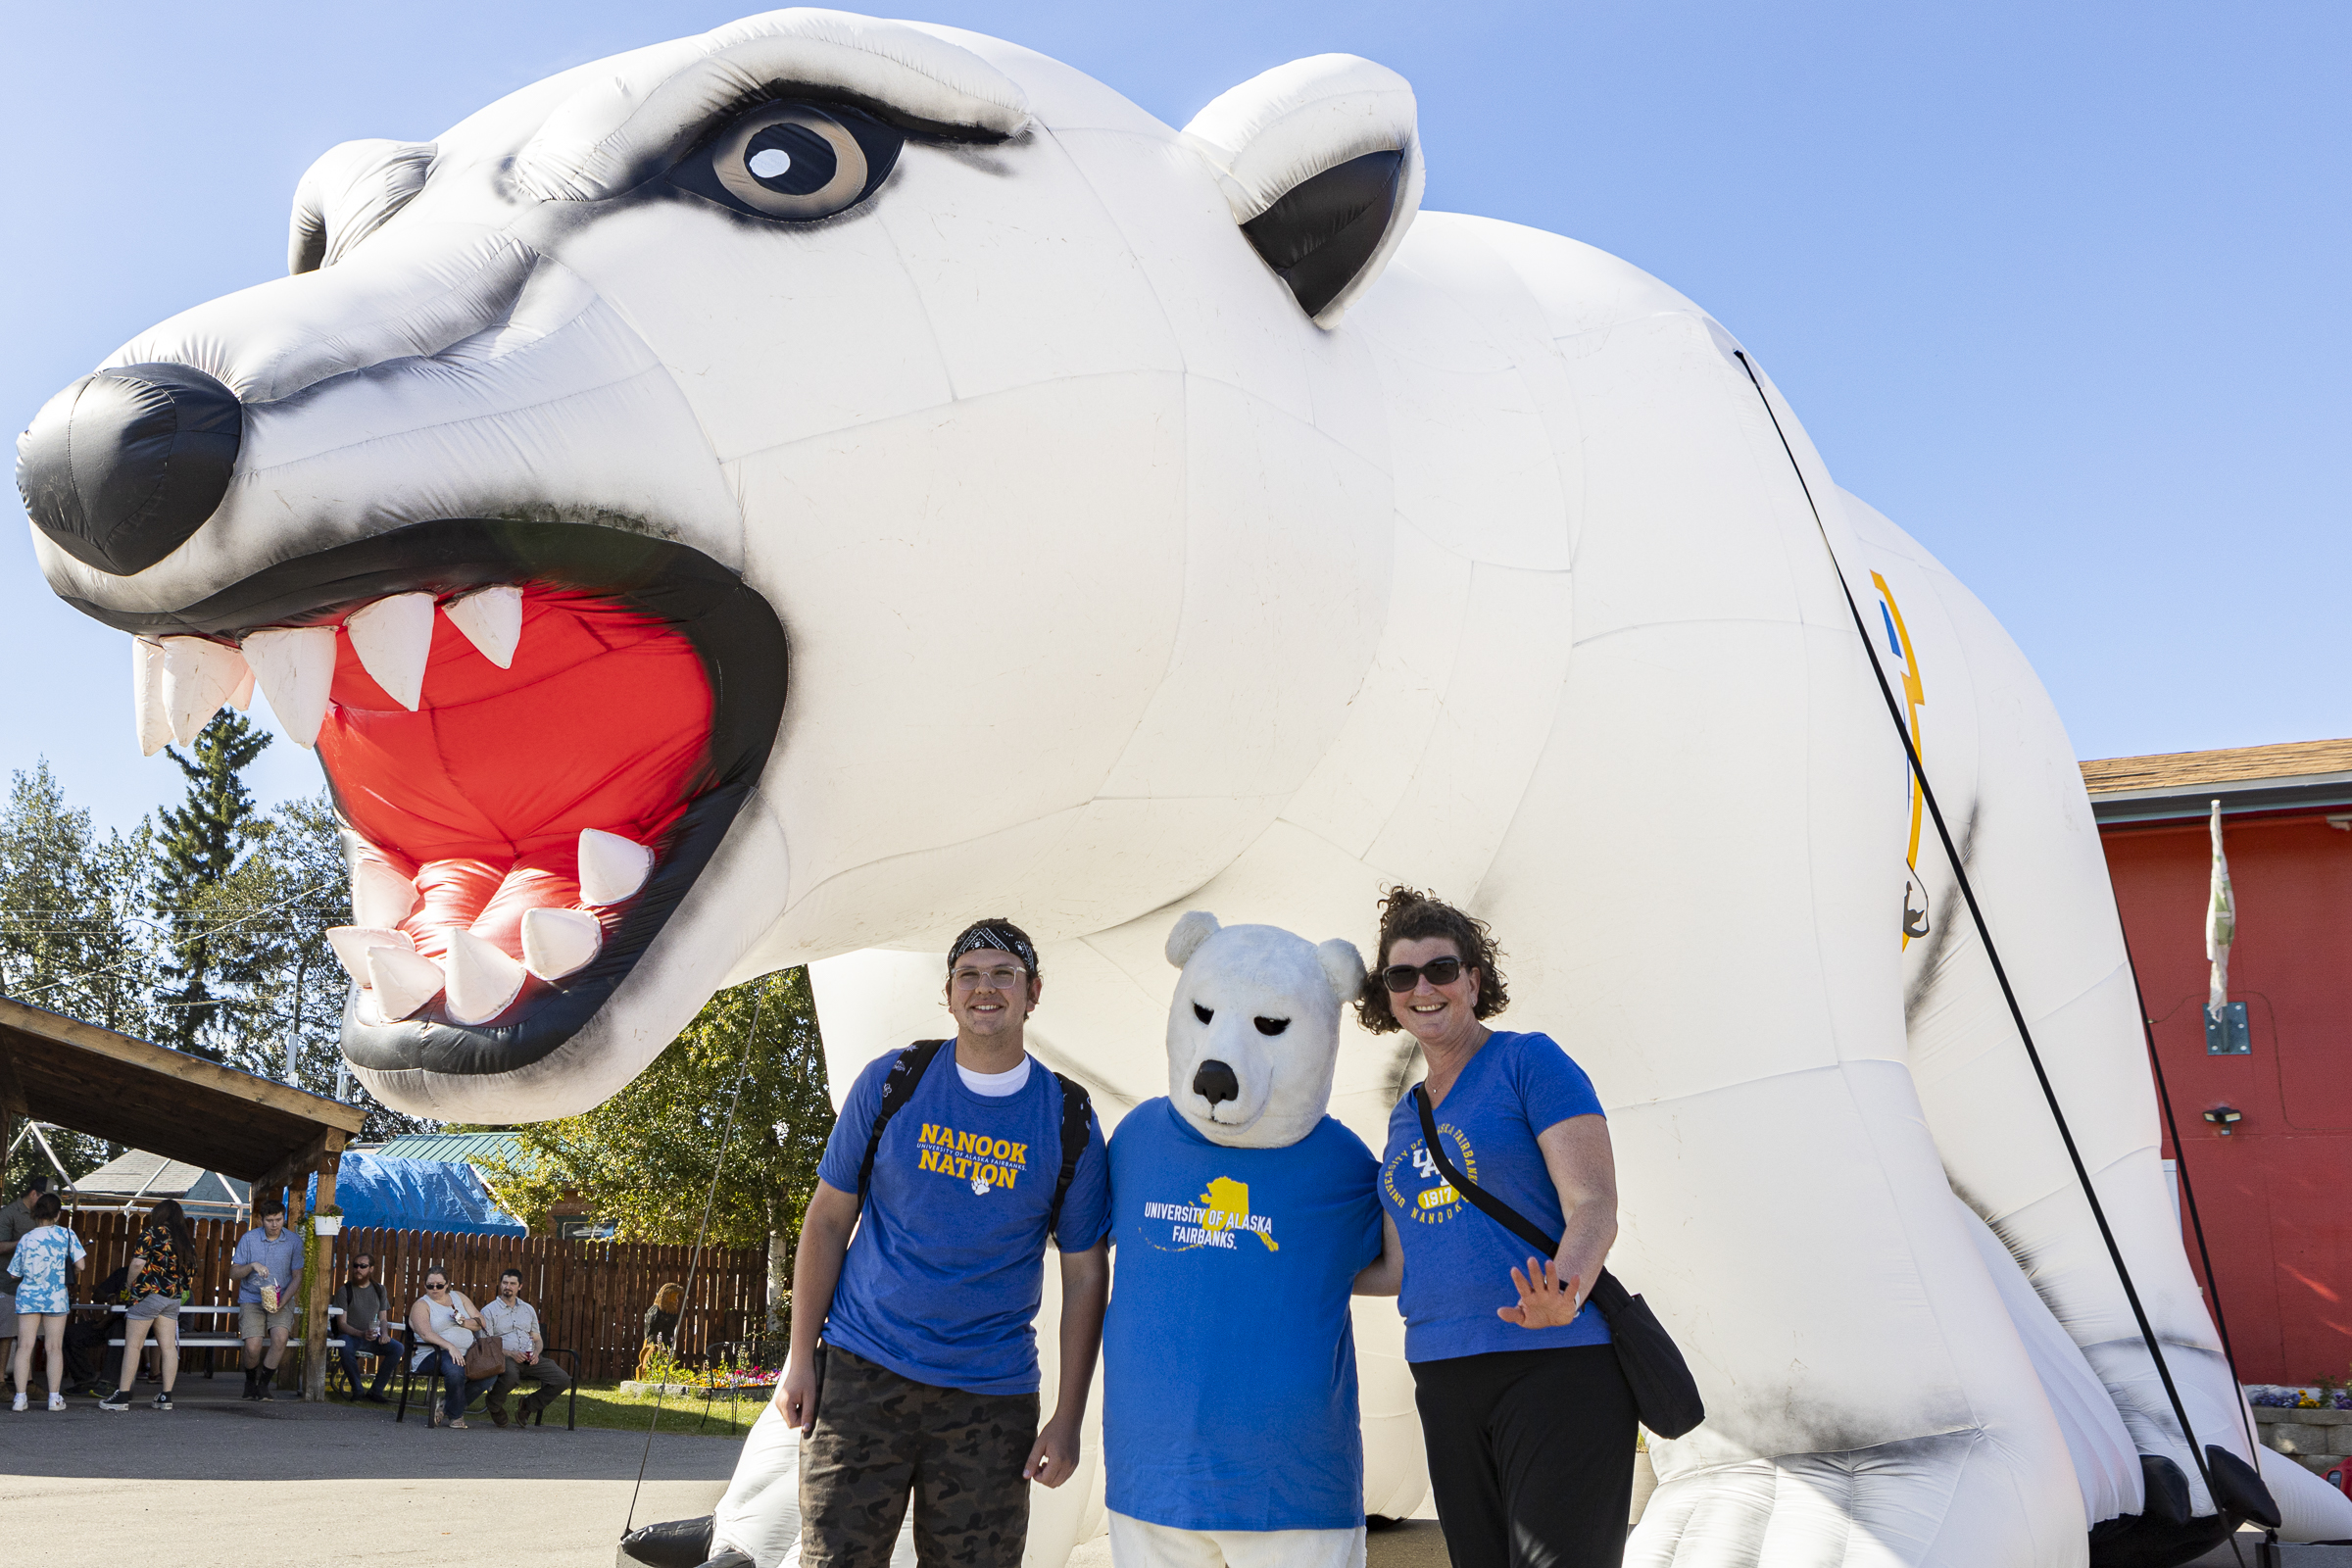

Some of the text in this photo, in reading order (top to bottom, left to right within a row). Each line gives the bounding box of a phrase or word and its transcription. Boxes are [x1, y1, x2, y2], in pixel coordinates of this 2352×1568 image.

[916, 1143, 954, 1155] UNIVERSITY
[964, 1153, 989, 1163] ALASKA
[918, 1123, 1028, 1164] NANOOK
[1452, 1128, 1478, 1185] FAIRBANK
[918, 1149, 1018, 1190] NATION
[1423, 1187, 1452, 1208] 1917
[1144, 1201, 1272, 1234] UNIVERSITY OF ALASKA
[1172, 1225, 1238, 1250] FAIRBANKS.
